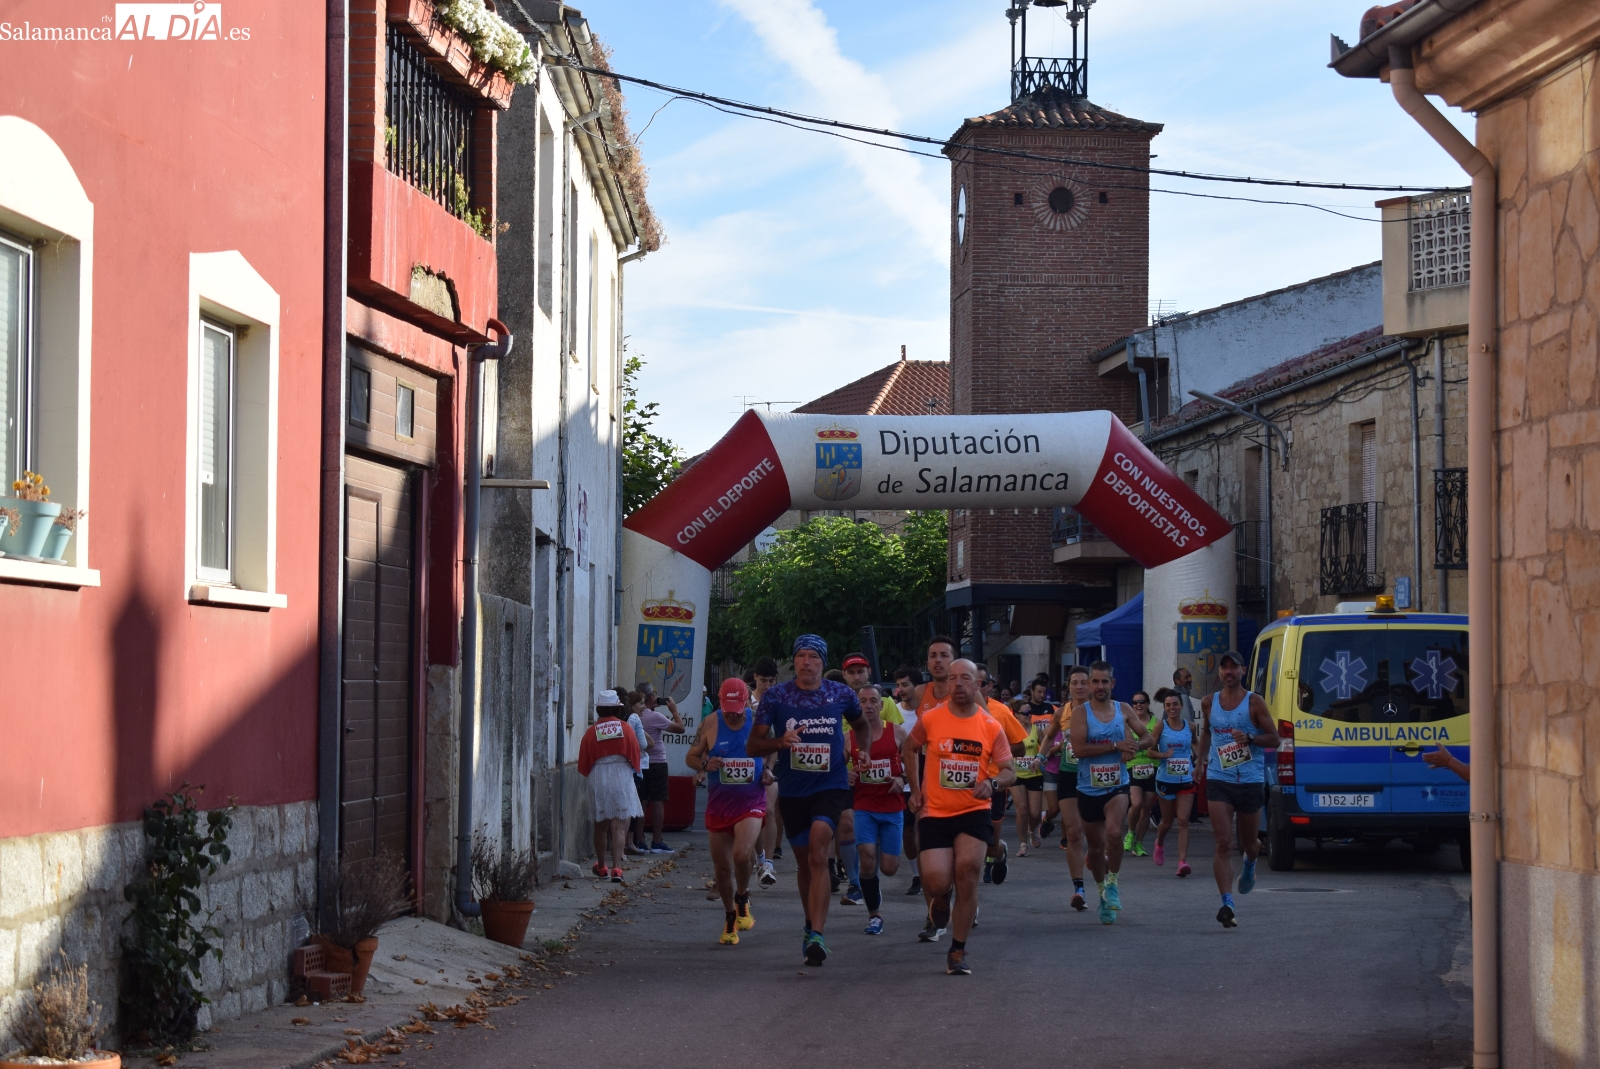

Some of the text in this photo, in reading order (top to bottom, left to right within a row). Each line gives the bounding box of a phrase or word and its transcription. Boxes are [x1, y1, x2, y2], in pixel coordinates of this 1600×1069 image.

[879, 428, 1040, 462] Diputación
[877, 466, 1069, 494] de Salamanca
[1113, 452, 1208, 537] CON NUESTROS
[676, 457, 775, 545] CON EL DEPORTE
[1103, 470, 1190, 548] DEPORTISTAS
[798, 716, 838, 727] apaches
[1295, 719, 1323, 729] 4126
[802, 726, 834, 735] running
[1331, 726, 1450, 741] AMBULANCIA
[792, 746, 830, 754] bedunia
[798, 754, 822, 765] 240
[1225, 749, 1245, 763] 202
[941, 761, 979, 772] bedunia
[1091, 765, 1120, 773] bedunia
[726, 768, 748, 779] 233
[866, 769, 885, 778] 210
[946, 771, 971, 783] 205
[1097, 772, 1116, 782] 235
[1322, 796, 1370, 806] 1162 JPF
